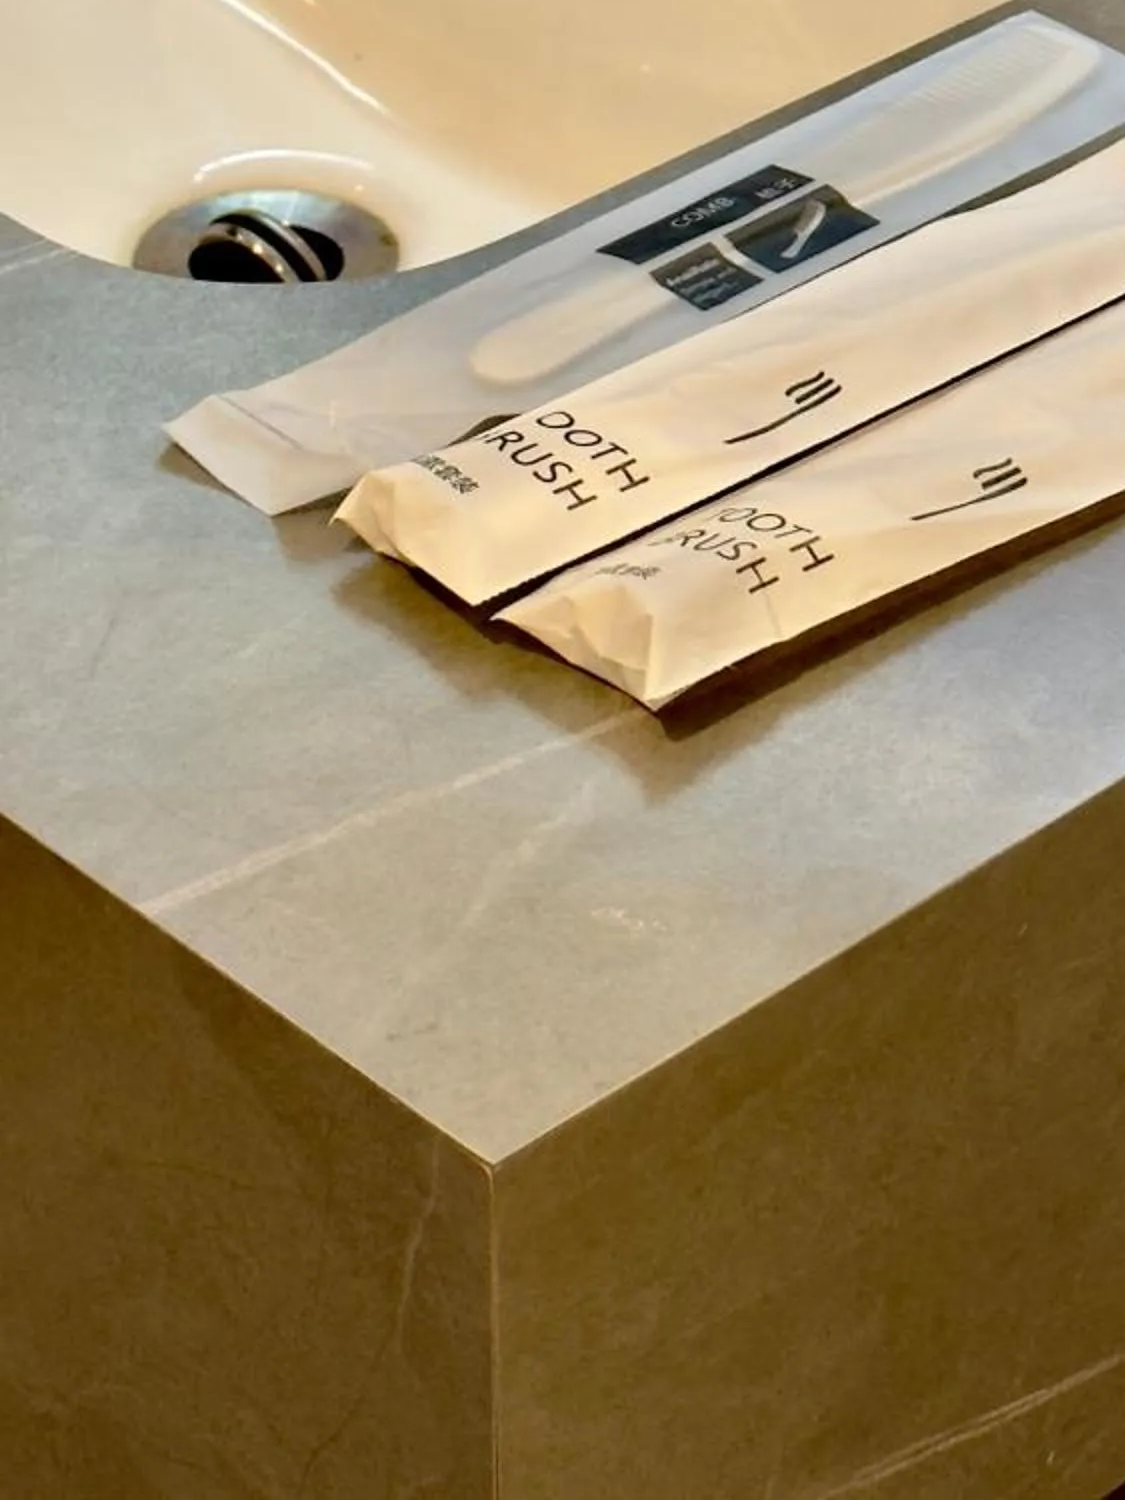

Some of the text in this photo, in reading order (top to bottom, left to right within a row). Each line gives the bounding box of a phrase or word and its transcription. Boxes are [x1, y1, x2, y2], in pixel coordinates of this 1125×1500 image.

[670, 196, 738, 229] COMB
[483, 430, 598, 511] RUSH
[674, 528, 780, 594] RUSH
[717, 506, 835, 572] OOTH
